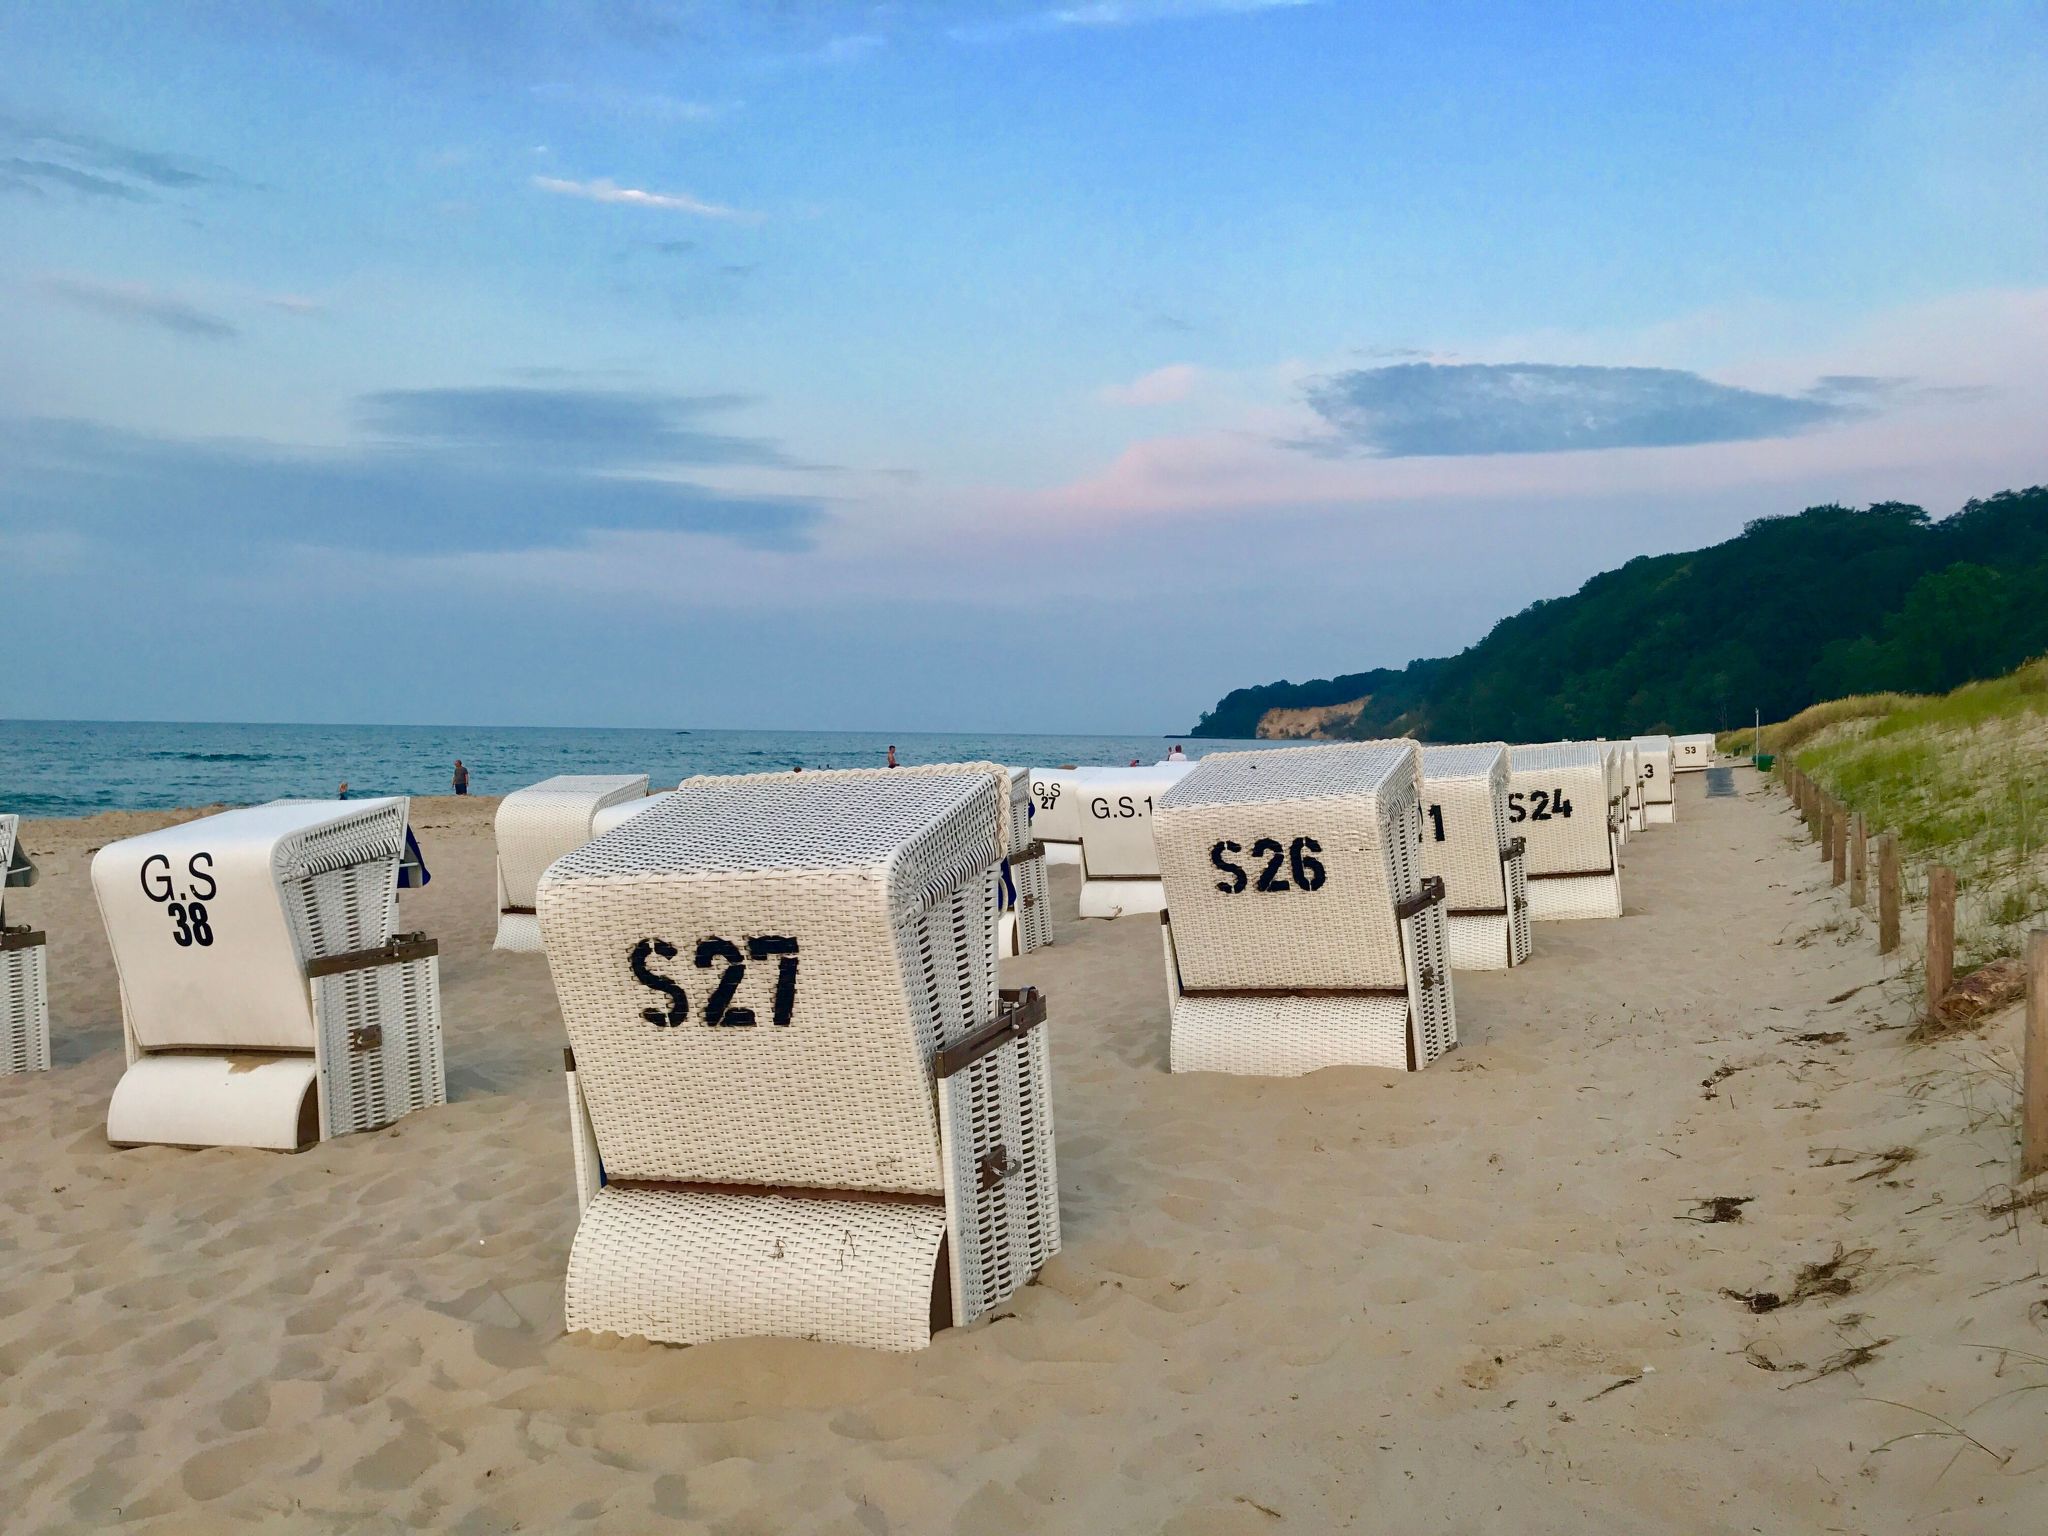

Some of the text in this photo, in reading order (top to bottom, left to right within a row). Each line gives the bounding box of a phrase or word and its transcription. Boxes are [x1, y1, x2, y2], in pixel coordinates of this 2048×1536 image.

[1685, 746, 1697, 755] S3
[1032, 781, 1061, 798] G.S
[1041, 796, 1056, 810] 27
[1508, 789, 1573, 823] S24
[141, 853, 217, 903] G.S
[1210, 836, 1326, 893] S26
[168, 902, 214, 947] 38
[629, 931, 798, 1028] S27
